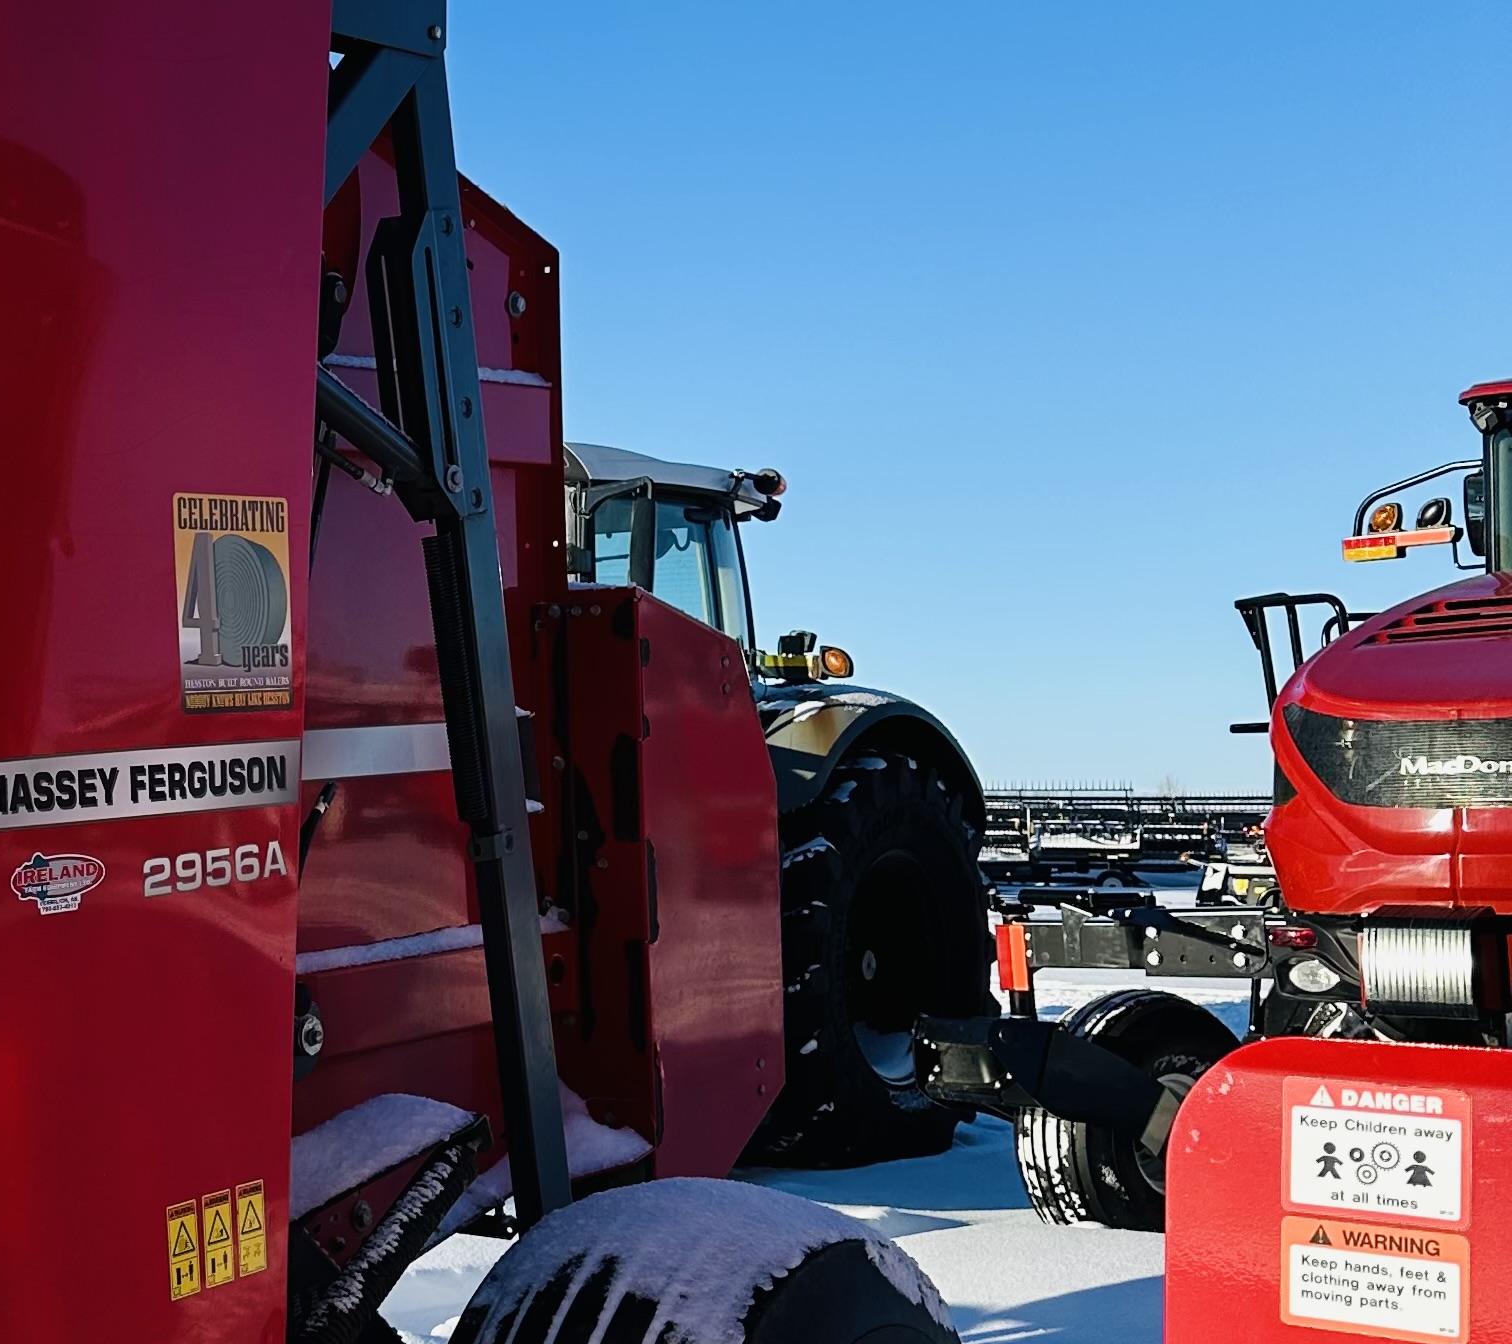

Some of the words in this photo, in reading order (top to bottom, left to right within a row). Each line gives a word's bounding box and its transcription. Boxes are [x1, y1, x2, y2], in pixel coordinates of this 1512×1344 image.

[177, 497, 285, 533] CELEBRATING
[241, 644, 289, 672] years
[129, 755, 287, 804] FERGUSON
[16, 862, 98, 887] IRELAND
[144, 841, 287, 897] 2956A
[1341, 1089, 1443, 1114] DANGER
[1300, 1115, 1338, 1131] Keep
[1345, 1119, 1407, 1135] Children
[1414, 1128, 1453, 1142] away
[1331, 1191, 1345, 1201] at
[1352, 1192, 1369, 1204] all
[1377, 1194, 1418, 1210] times
[1343, 1230, 1441, 1257] WARNING
[1301, 1254, 1338, 1270] Keep
[1345, 1260, 1392, 1278] hands,
[1400, 1267, 1429, 1281] feet
[1437, 1271, 1447, 1283] &
[1301, 1272, 1359, 1290] clothing
[1367, 1280, 1404, 1296] away
[1412, 1285, 1447, 1300] from
[1301, 1289, 1352, 1306] moving
[1360, 1296, 1403, 1311] parts.
